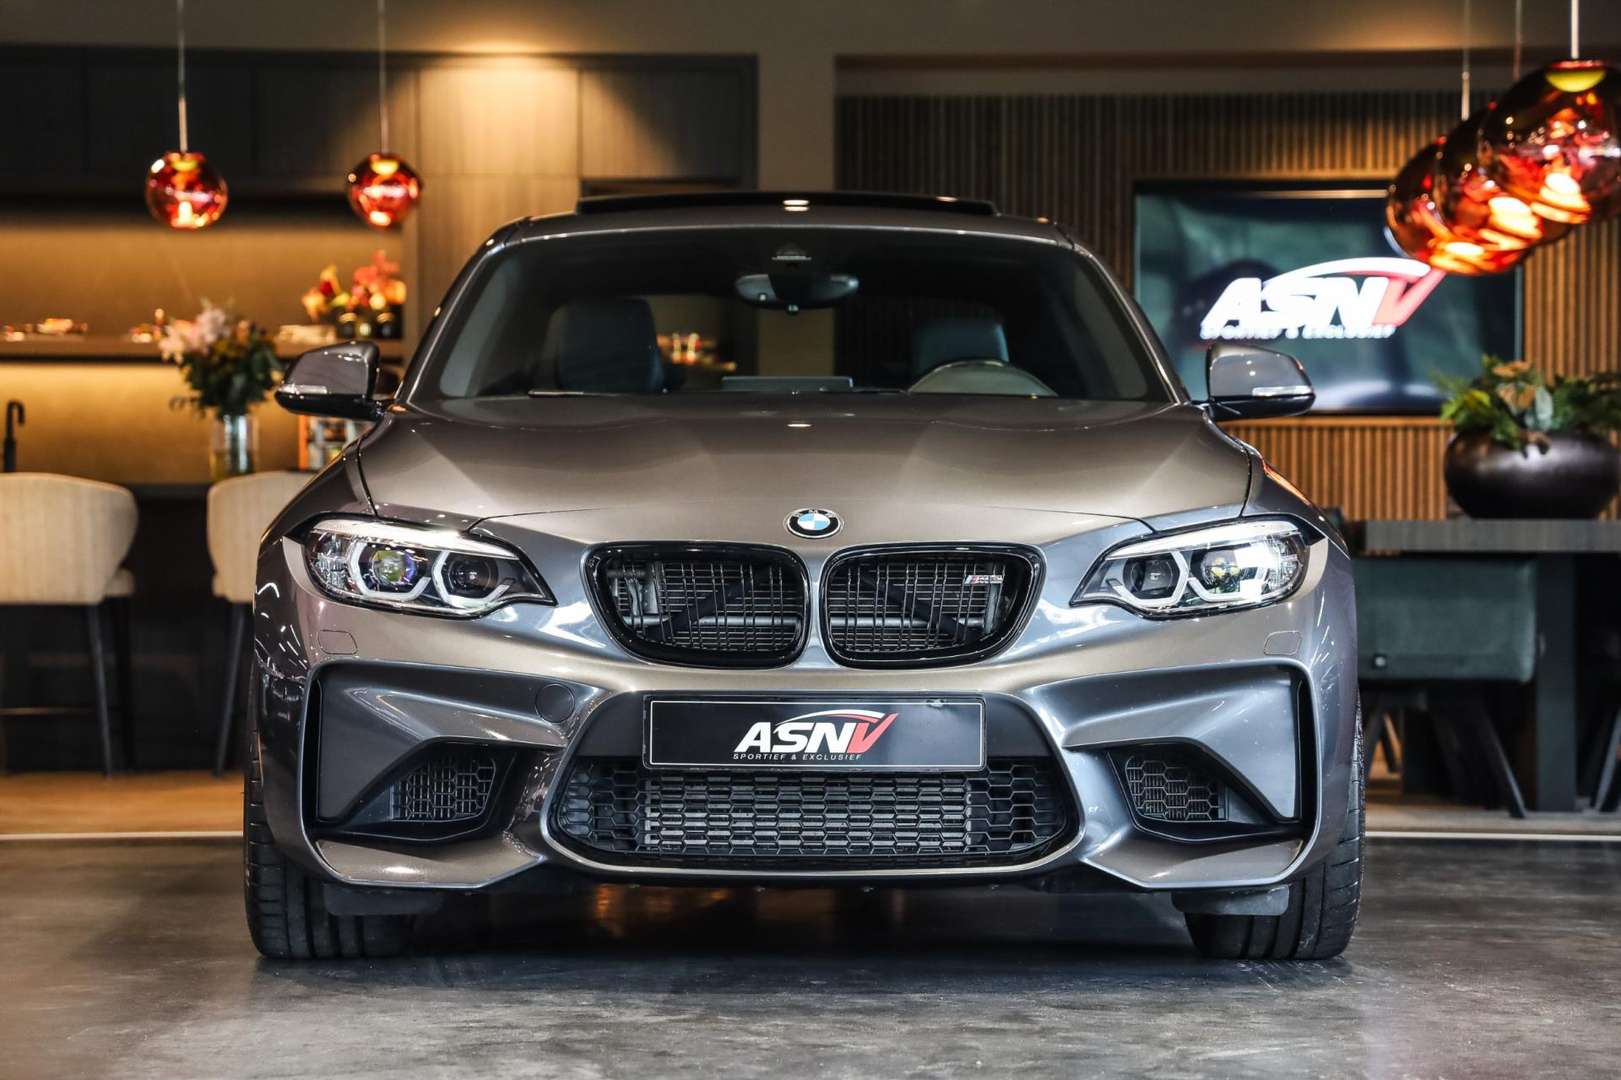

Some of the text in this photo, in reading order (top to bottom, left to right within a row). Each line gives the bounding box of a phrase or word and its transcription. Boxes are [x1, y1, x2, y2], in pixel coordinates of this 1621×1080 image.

[1200, 258, 1447, 327] ASNV
[734, 709, 898, 754] ASNV
[733, 753, 863, 761] SPORTIEF & EXCLUSIEF
